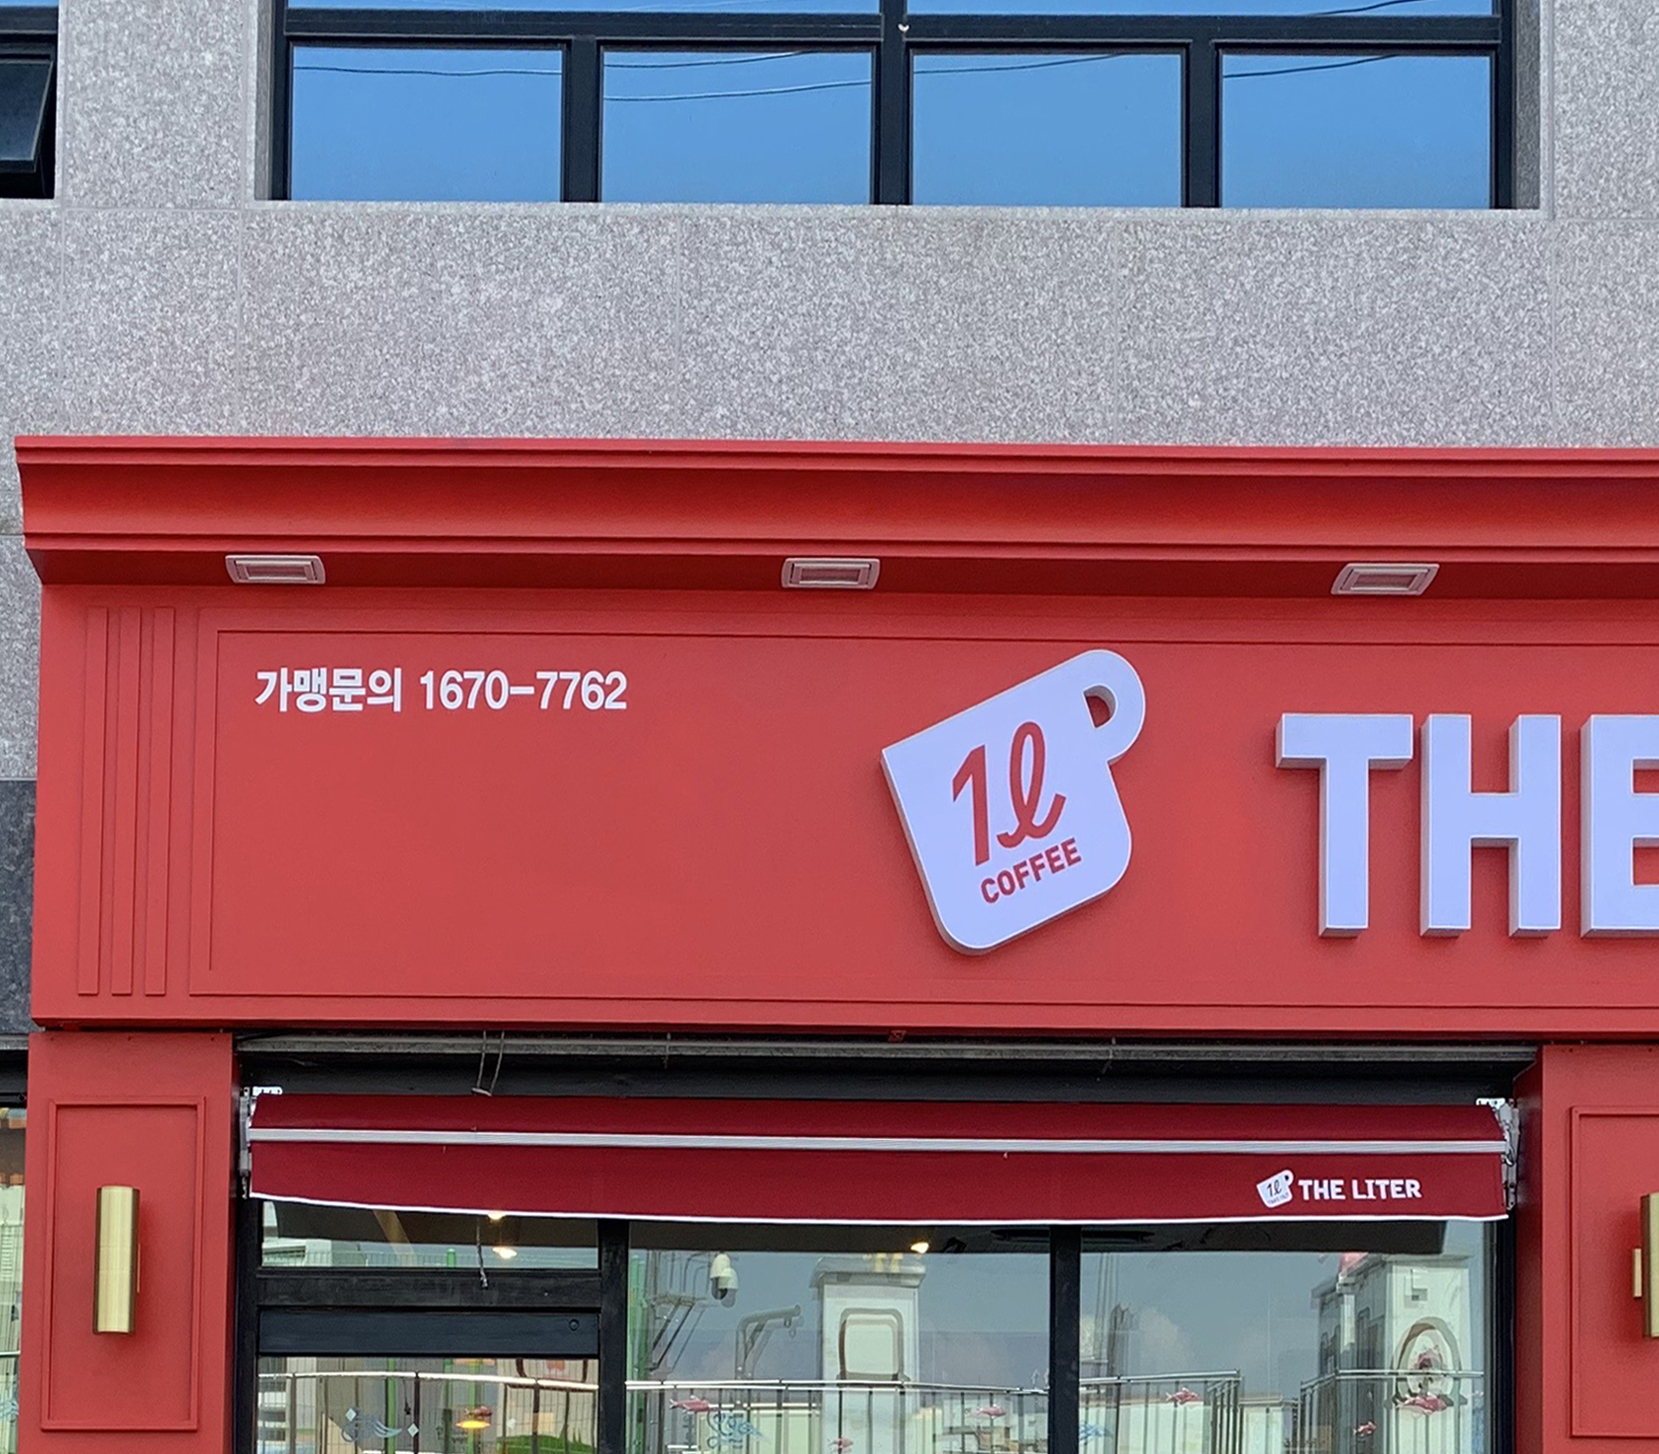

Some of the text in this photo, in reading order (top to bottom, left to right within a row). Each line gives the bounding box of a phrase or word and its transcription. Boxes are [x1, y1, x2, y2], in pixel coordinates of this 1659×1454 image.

[256, 667, 628, 713] 가맹문의 1670-7762
[980, 837, 1082, 904] COFFEE
[1297, 1179, 1346, 1200] THE
[1352, 1179, 1422, 1200] LITER
